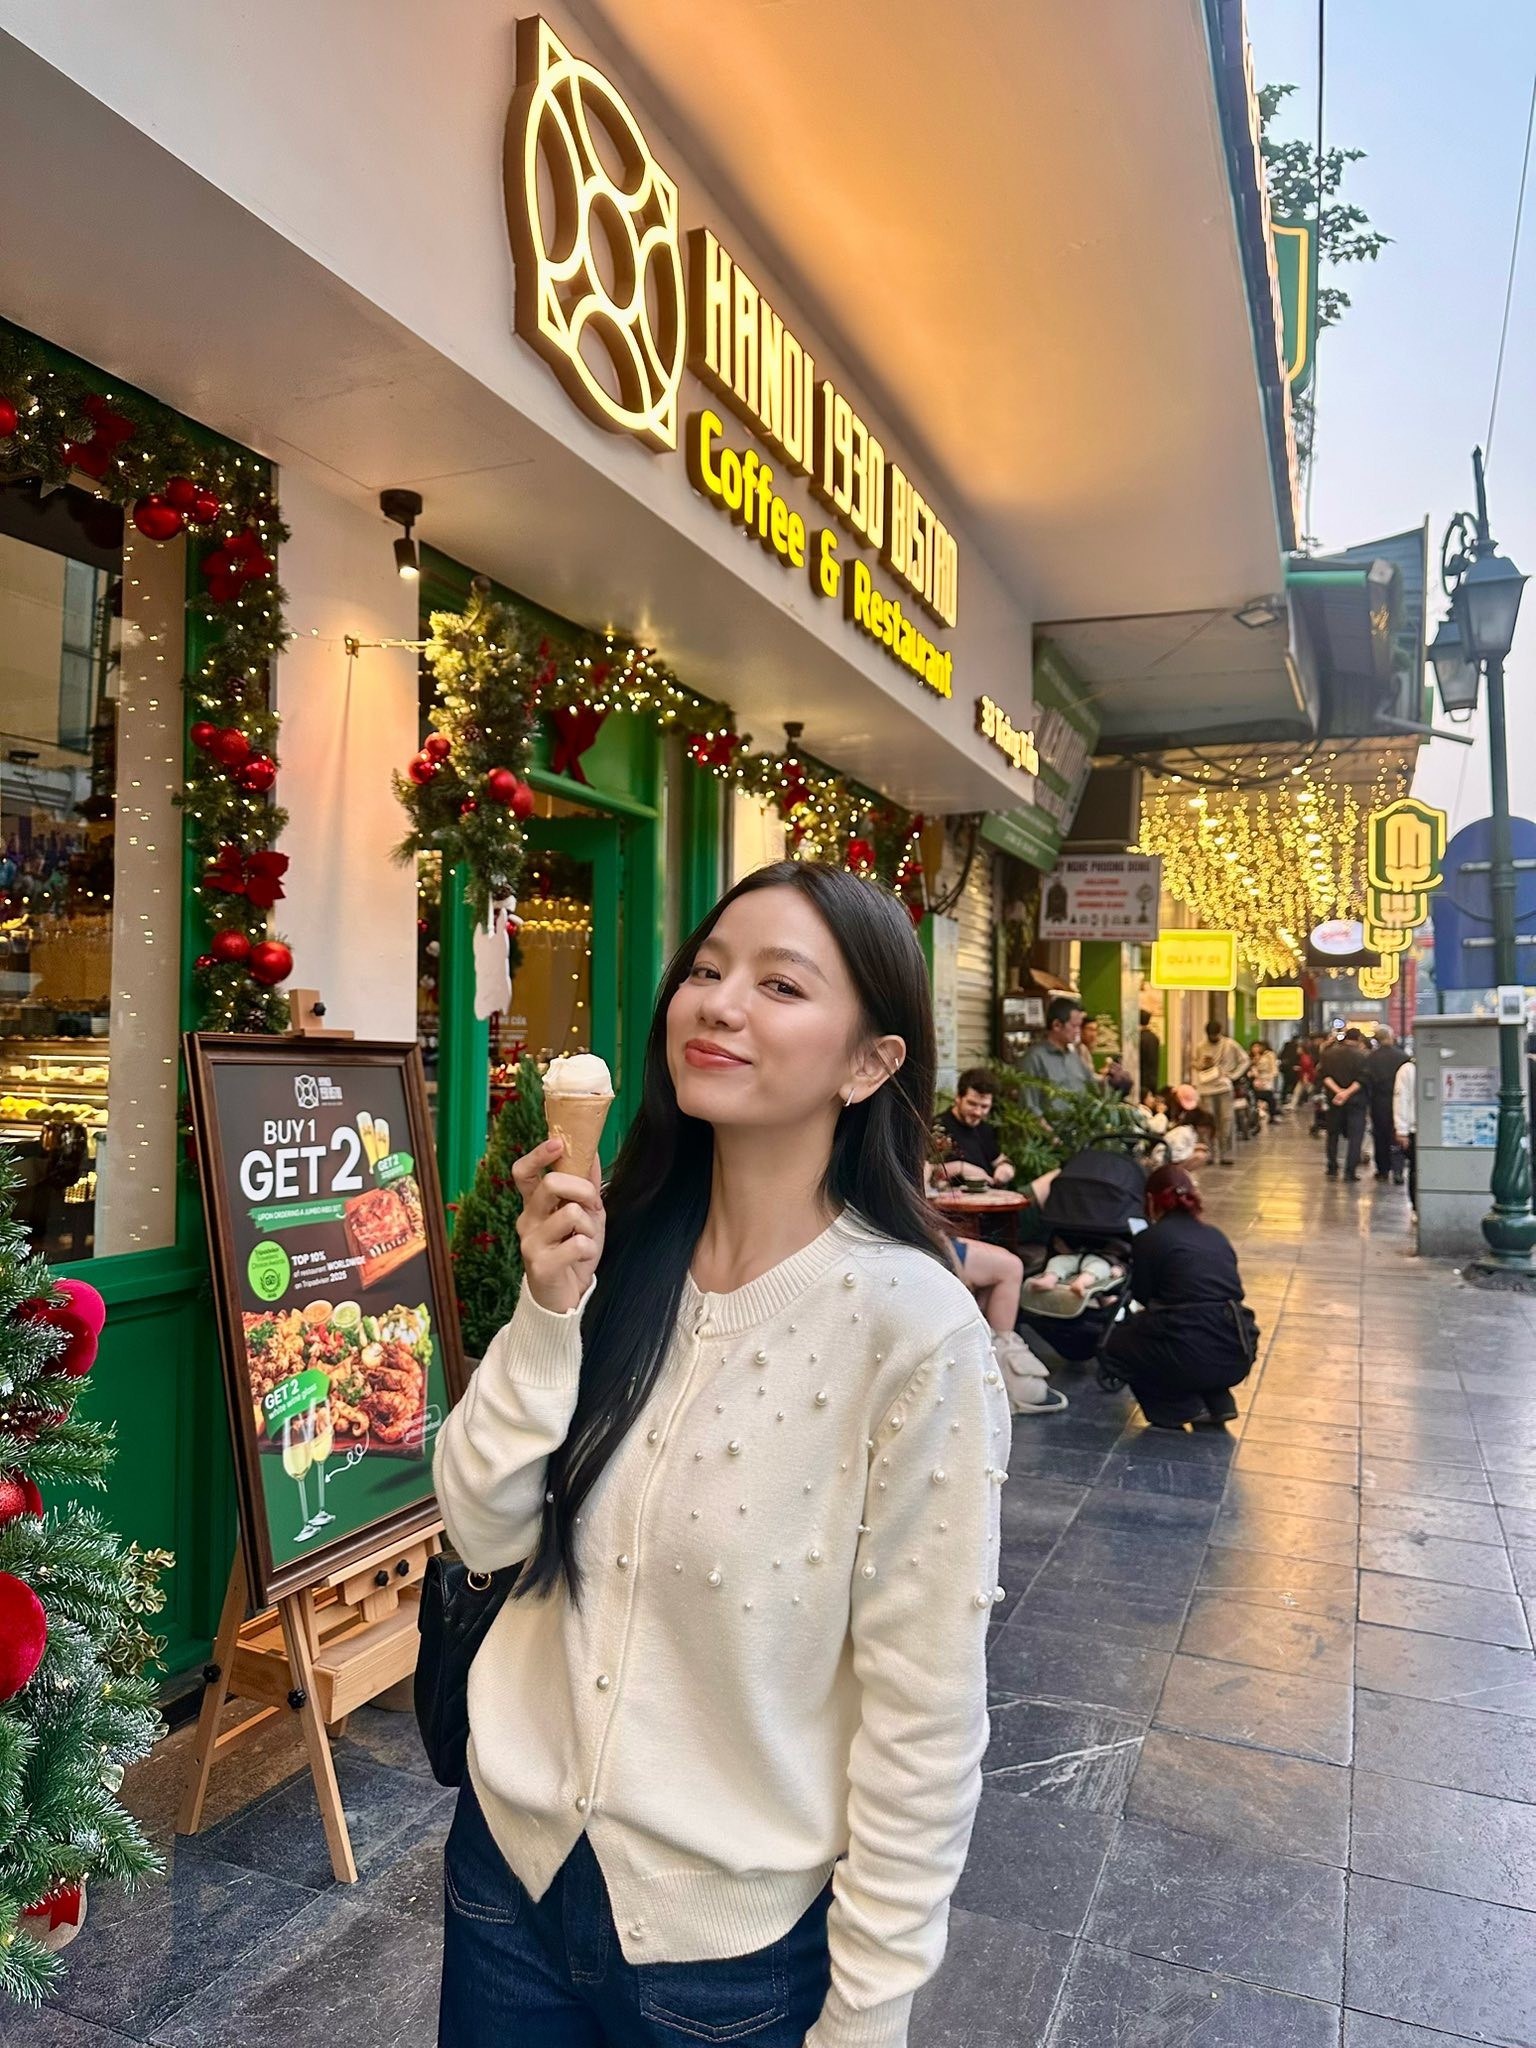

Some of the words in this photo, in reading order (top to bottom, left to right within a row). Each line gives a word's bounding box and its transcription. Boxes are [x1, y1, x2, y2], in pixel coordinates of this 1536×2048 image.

[703, 228, 815, 475] HANOI
[822, 379, 885, 549] 1930
[890, 463, 958, 628] BISTRO
[700, 409, 805, 568] Coffee
[820, 527, 841, 598] &
[854, 559, 953, 699] Restaurant
[263, 1120, 305, 1145] BUY
[307, 1119, 316, 1142] 1
[239, 1146, 327, 1202] GET
[330, 1126, 363, 1192] 2
[377, 1156, 393, 1171] GET
[392, 1153, 400, 1166] 2
[290, 1254, 310, 1266] TOP
[310, 1250, 327, 1263] 10%
[264, 1383, 289, 1410] GET
[289, 1378, 300, 1395] 2
